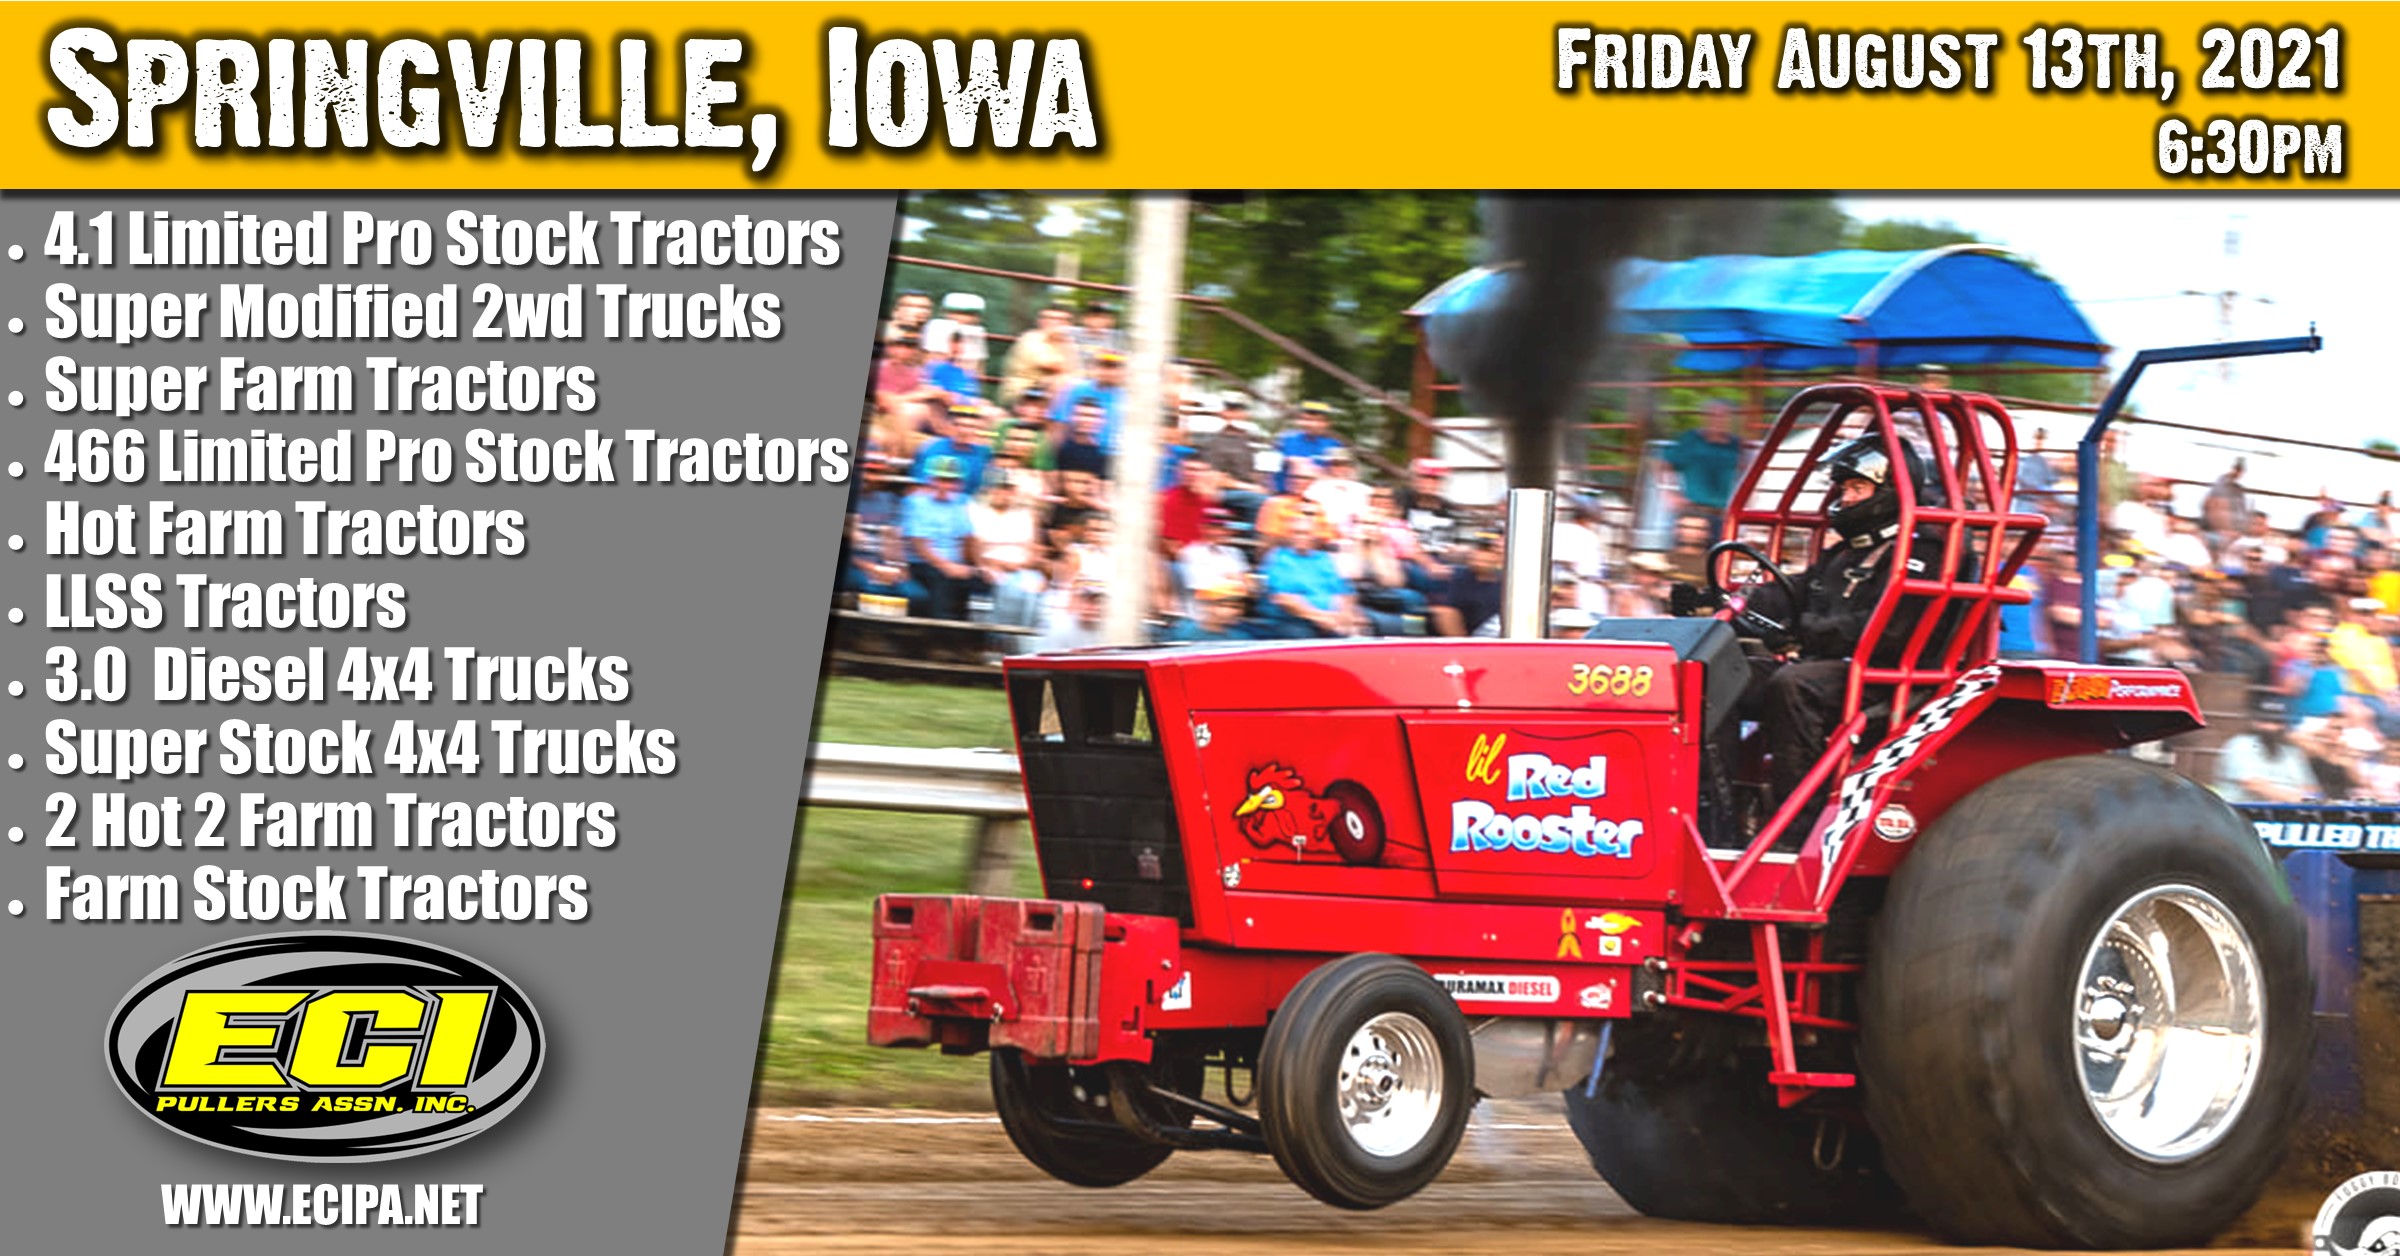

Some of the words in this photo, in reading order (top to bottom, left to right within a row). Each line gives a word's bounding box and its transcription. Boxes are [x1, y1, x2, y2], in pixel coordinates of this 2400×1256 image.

[1567, 662, 1654, 697] 3688
[1506, 752, 1607, 802] Red
[1449, 799, 1644, 860] Rooster
[1508, 981, 1553, 996] DIESEL
